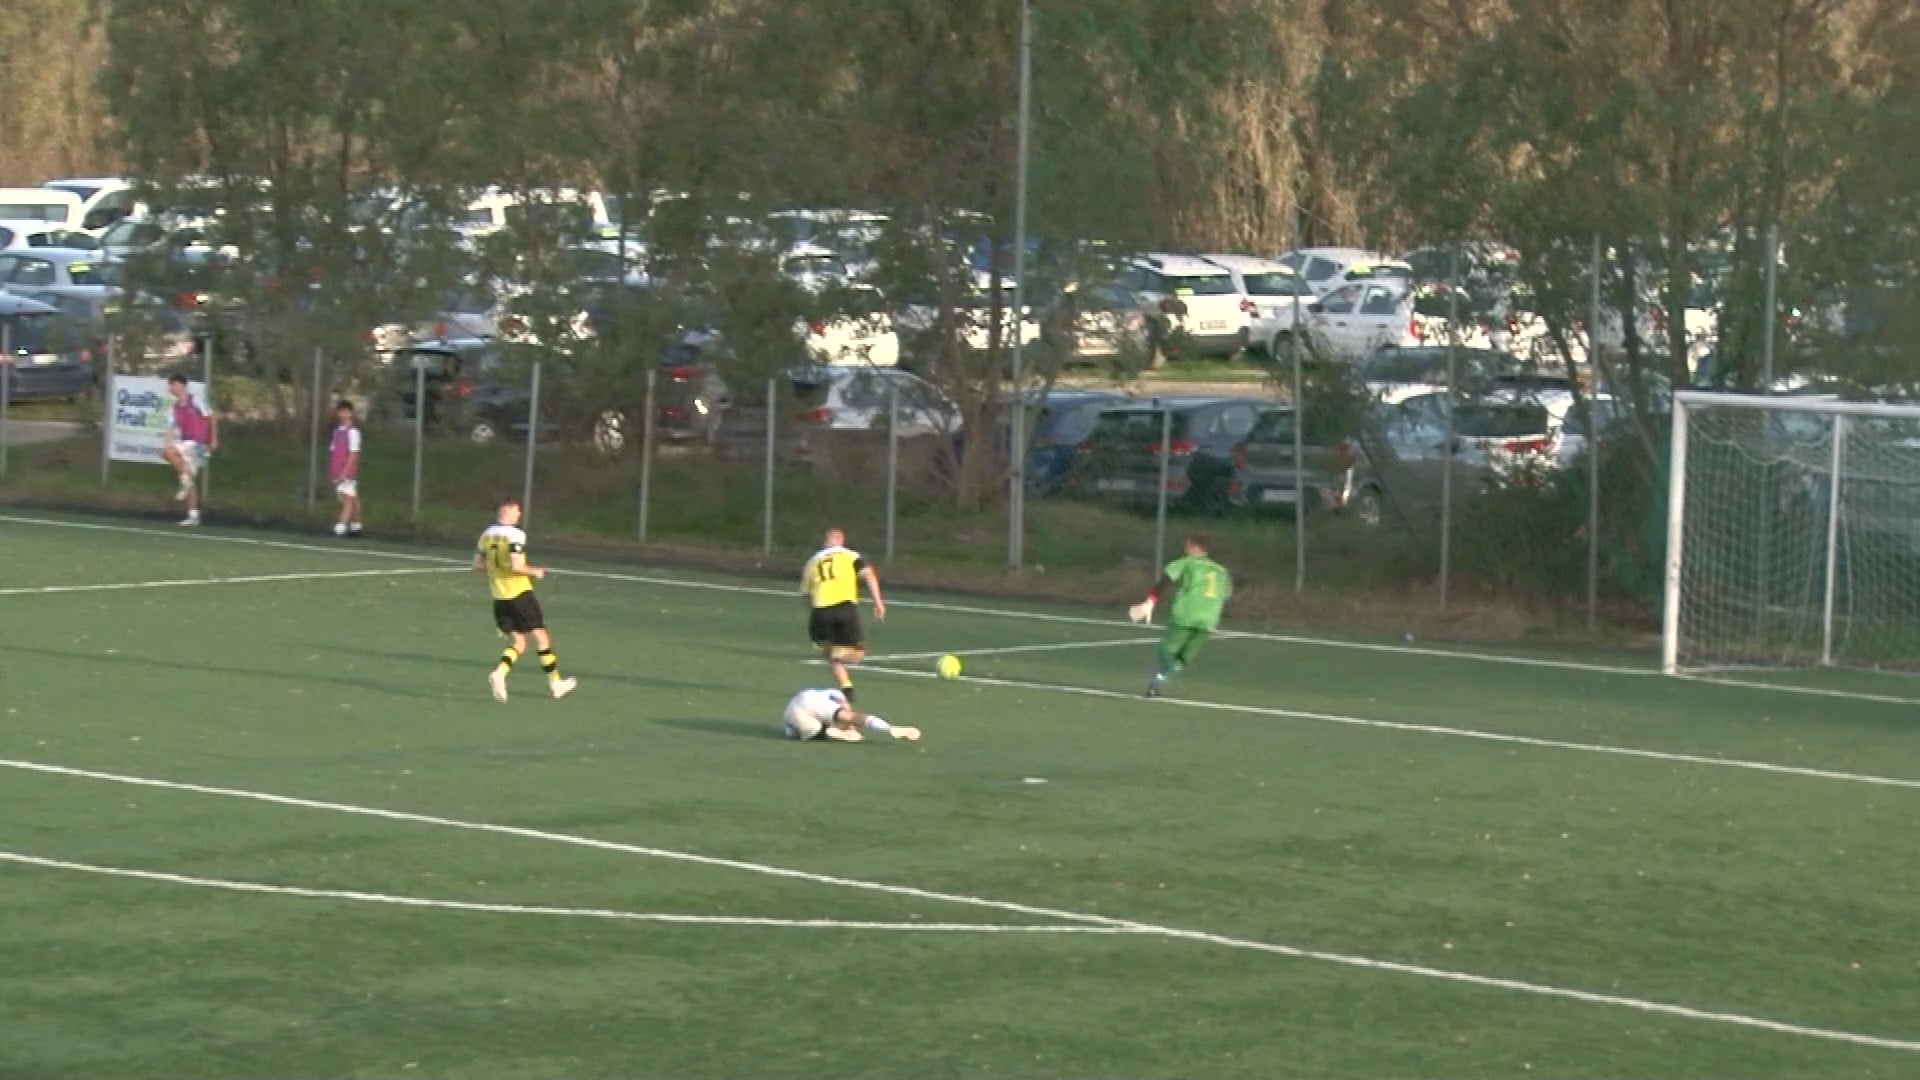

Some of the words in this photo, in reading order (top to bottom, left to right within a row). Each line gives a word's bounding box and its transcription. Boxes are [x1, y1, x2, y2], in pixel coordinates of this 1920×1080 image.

[117, 388, 160, 412] Quality
[117, 407, 146, 427] Fruit
[817, 557, 834, 582] 17
[1202, 571, 1217, 598] 1
